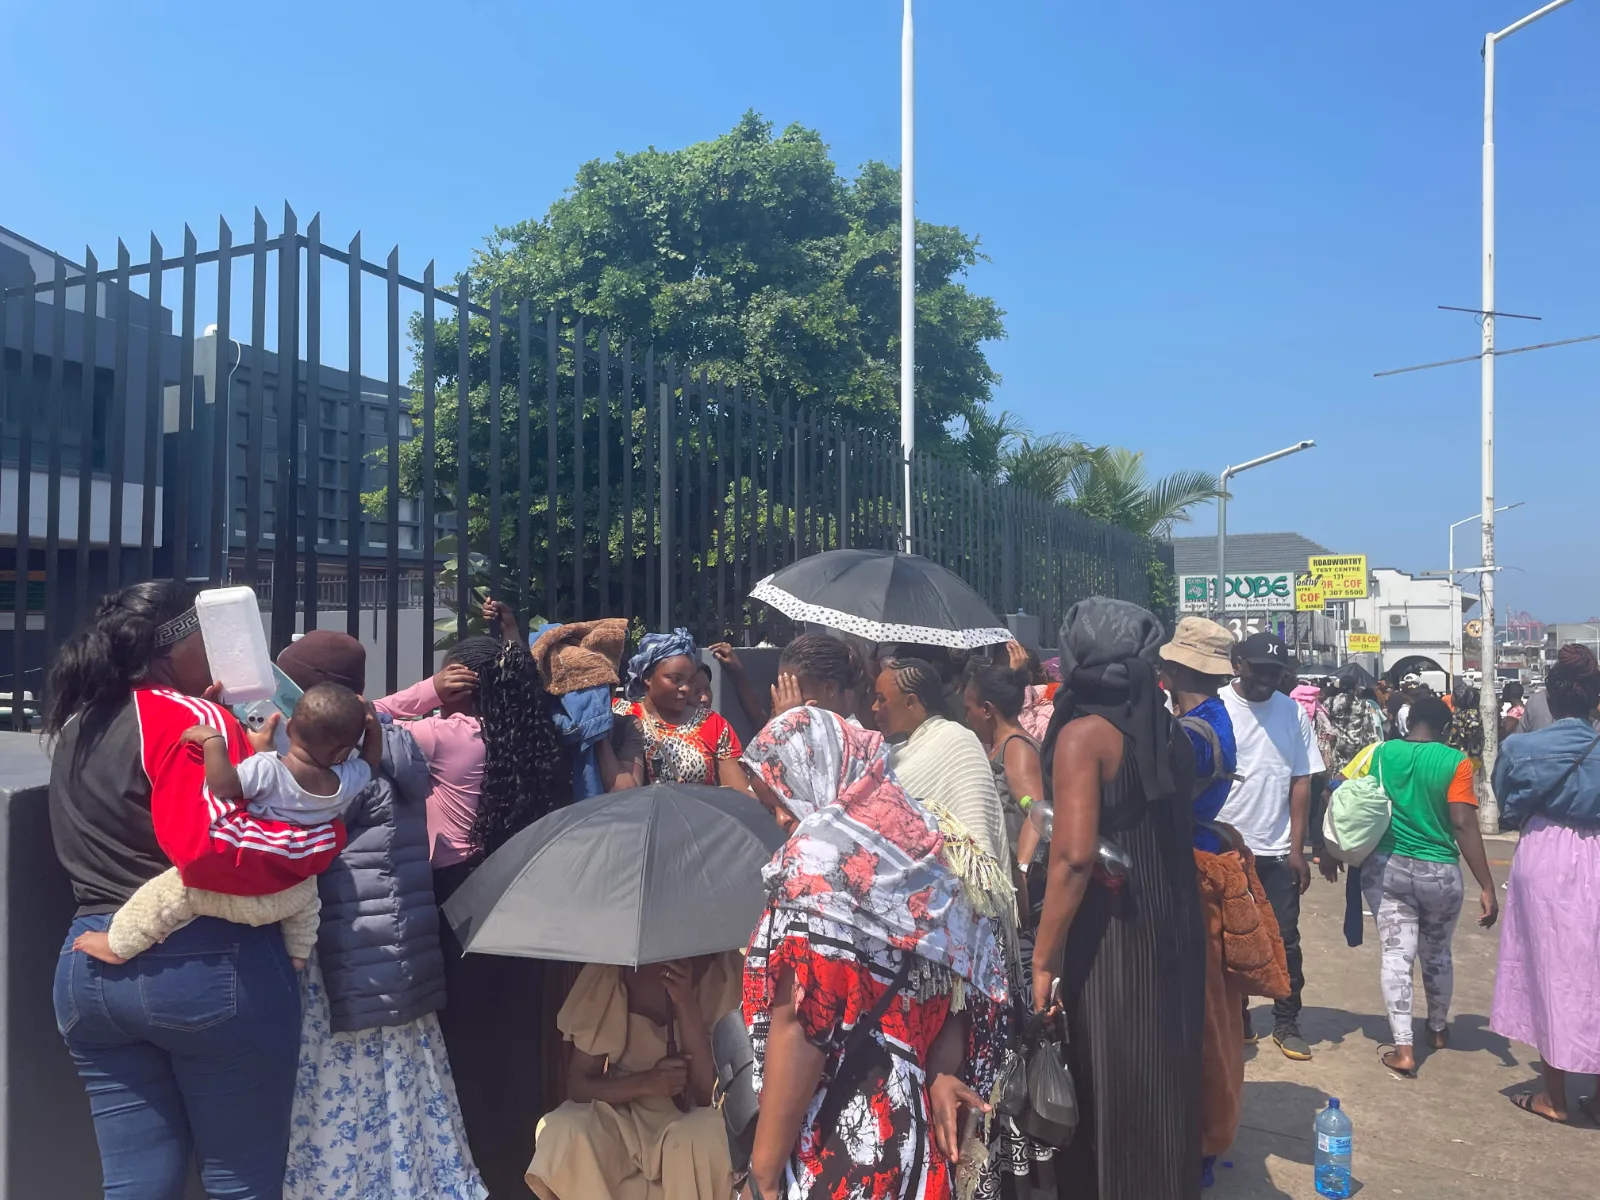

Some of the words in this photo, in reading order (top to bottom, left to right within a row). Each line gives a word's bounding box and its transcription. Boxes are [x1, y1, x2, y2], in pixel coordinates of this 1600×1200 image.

[1313, 558, 1362, 566] ROADWORTHY
[1344, 579, 1362, 588] COF
[1300, 593, 1320, 602] COF
